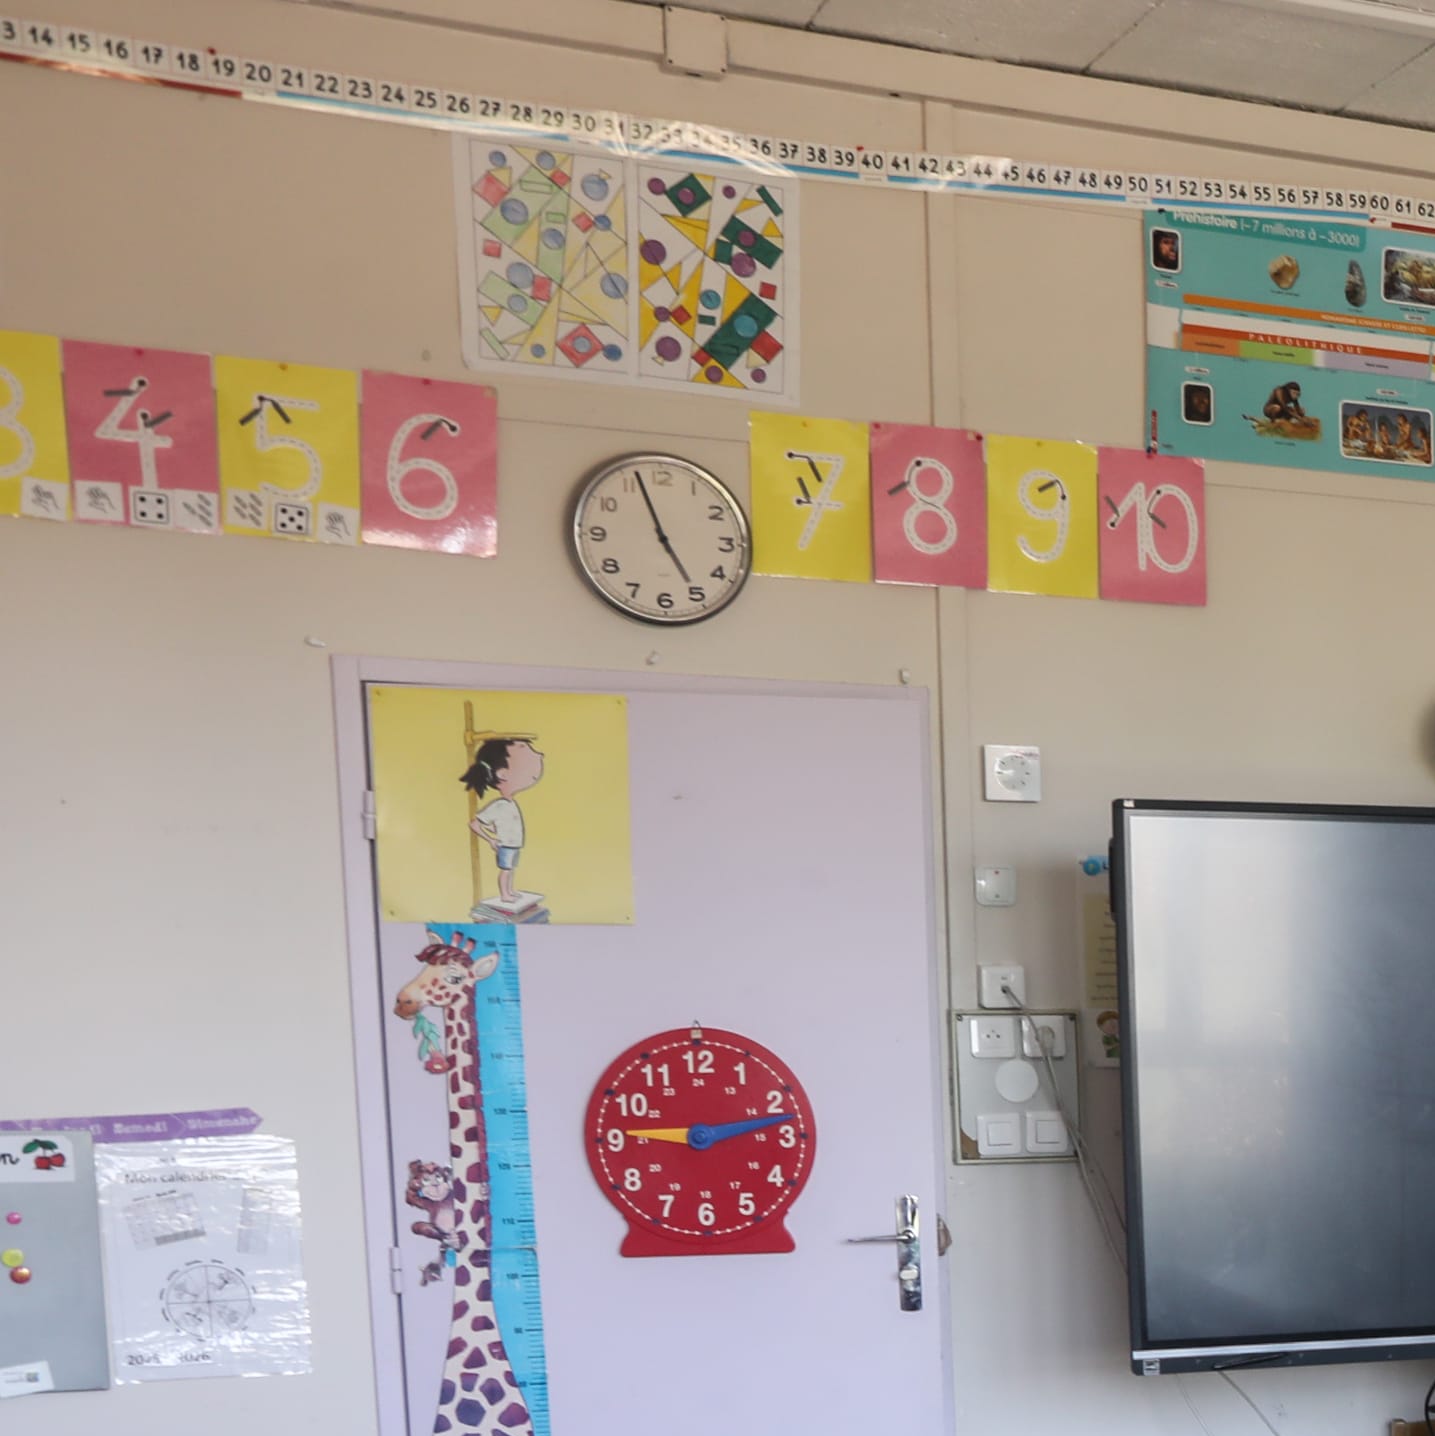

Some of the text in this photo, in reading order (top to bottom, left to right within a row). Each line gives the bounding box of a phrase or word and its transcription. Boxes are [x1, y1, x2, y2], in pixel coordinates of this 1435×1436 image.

[29, 26, 53, 45] 14
[104, 39, 129, 59] 16
[245, 63, 272, 83] 20
[314, 73, 338, 94] 22
[381, 84, 405, 103] 24
[510, 104, 533, 120] 28
[572, 113, 596, 132] 30
[750, 138, 772, 156] 36
[807, 146, 827, 164] 38
[861, 154, 884, 170] 40
[1026, 168, 1046, 184] 46
[1128, 176, 1148, 192] 50
[1178, 182, 1198, 198] 52
[1229, 184, 1247, 199] 54
[1325, 191, 1344, 207] 58
[1369, 195, 1390, 211] 60
[96, 377, 173, 489] 4
[258, 396, 323, 500] 5
[388, 413, 463, 520] 6
[623, 477, 636, 493] 11
[652, 471, 673, 487] 12
[691, 481, 697, 496] 1
[600, 497, 617, 512] 10
[708, 505, 724, 521] 2
[786, 451, 1198, 573] 7 8 9 10
[590, 526, 607, 542] 9
[717, 537, 735, 553] 3
[602, 558, 620, 574] 8
[710, 565, 726, 580] 4
[625, 582, 640, 598] 7
[656, 593, 674, 609] 6
[688, 586, 706, 602] 5
[682, 1050, 715, 1074] 12
[641, 1064, 670, 1086] 11
[733, 1062, 746, 1085] 1
[724, 1086, 736, 1095] 13
[615, 1093, 648, 1117] 10
[766, 1090, 784, 1114] 2
[607, 1129, 625, 1152] 9
[778, 1125, 796, 1148] 3
[624, 1168, 642, 1191] 8
[767, 1164, 784, 1187] 4
[658, 1194, 674, 1217] 7
[698, 1203, 715, 1226] 6
[738, 1192, 755, 1216] 5
